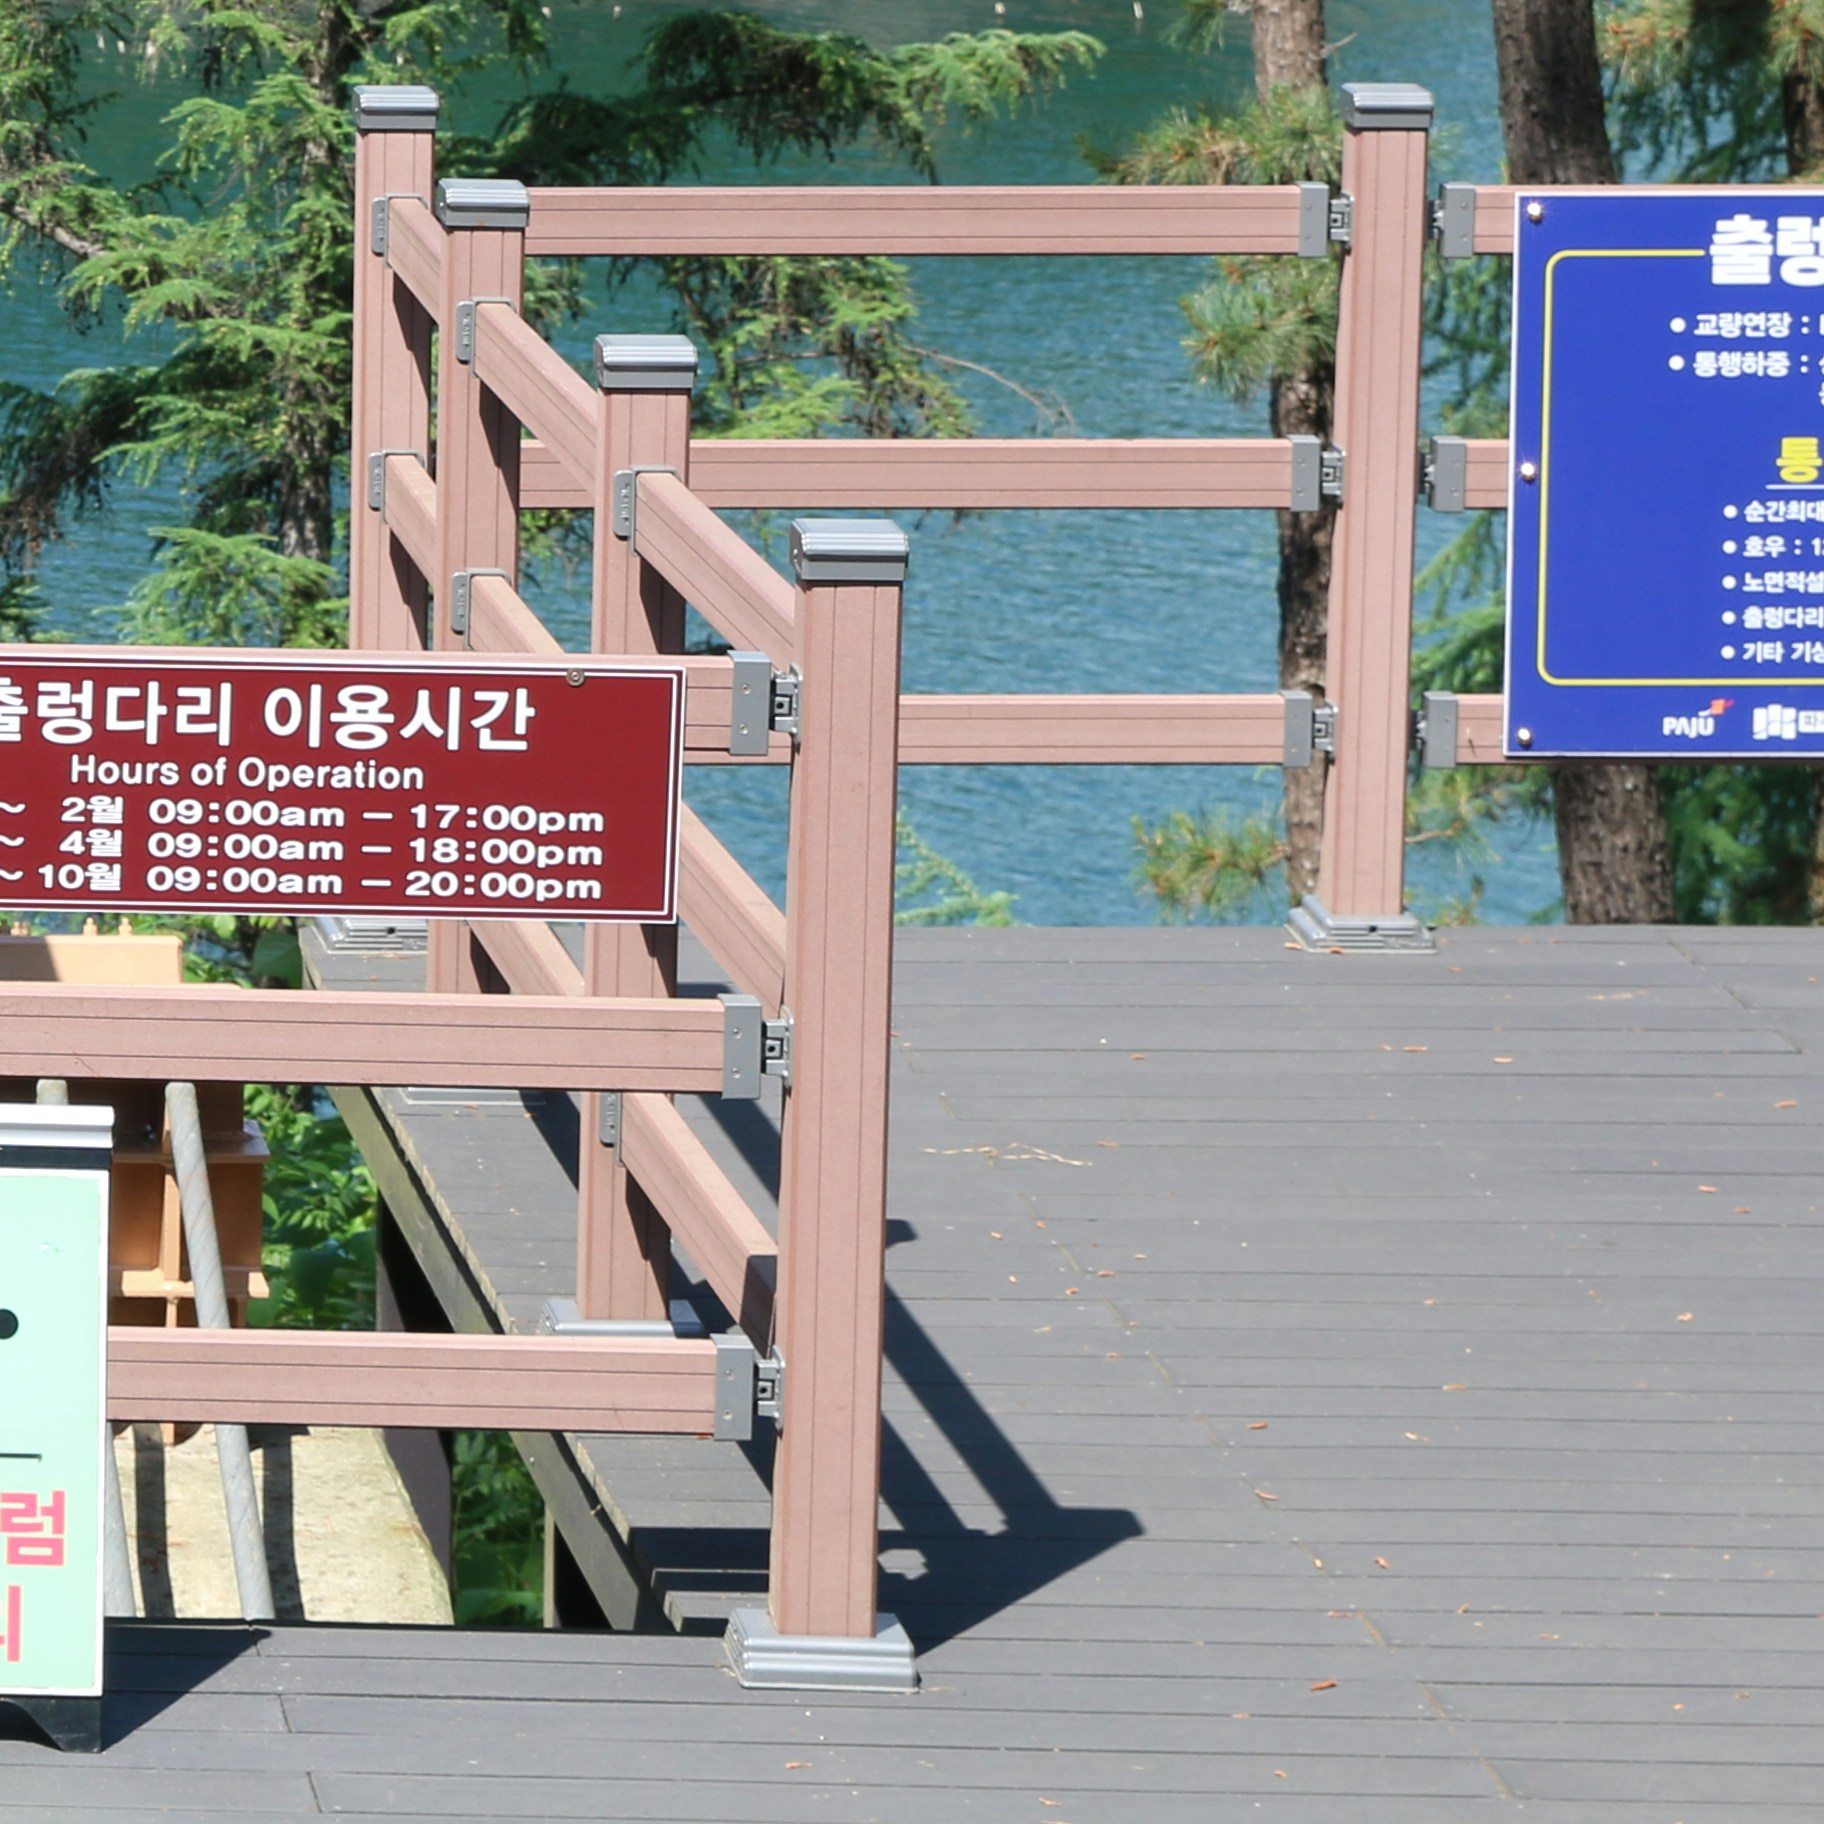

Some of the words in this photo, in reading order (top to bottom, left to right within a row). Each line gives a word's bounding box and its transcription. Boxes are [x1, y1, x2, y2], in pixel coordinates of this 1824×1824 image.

[1694, 312, 1792, 338] 교량연장
[1693, 351, 1790, 377] 통행하중
[1743, 536, 1786, 557] 호우
[1743, 641, 1784, 663] 기타
[265, 684, 535, 750] 이용시간
[1663, 714, 1716, 738] PAJU
[71, 755, 179, 785] Hours
[191, 757, 226, 786] of
[239, 757, 423, 791] Operation
[61, 795, 123, 824] 2월
[149, 799, 344, 833] 09:00am
[411, 804, 603, 834] 17:00pm
[60, 828, 122, 857] 4월
[148, 832, 343, 860] 09:00am
[410, 838, 602, 868] 18:00pm
[39, 863, 121, 891] 10월
[147, 866, 342, 894] 09:00am
[405, 871, 601, 901] 20:00pm
